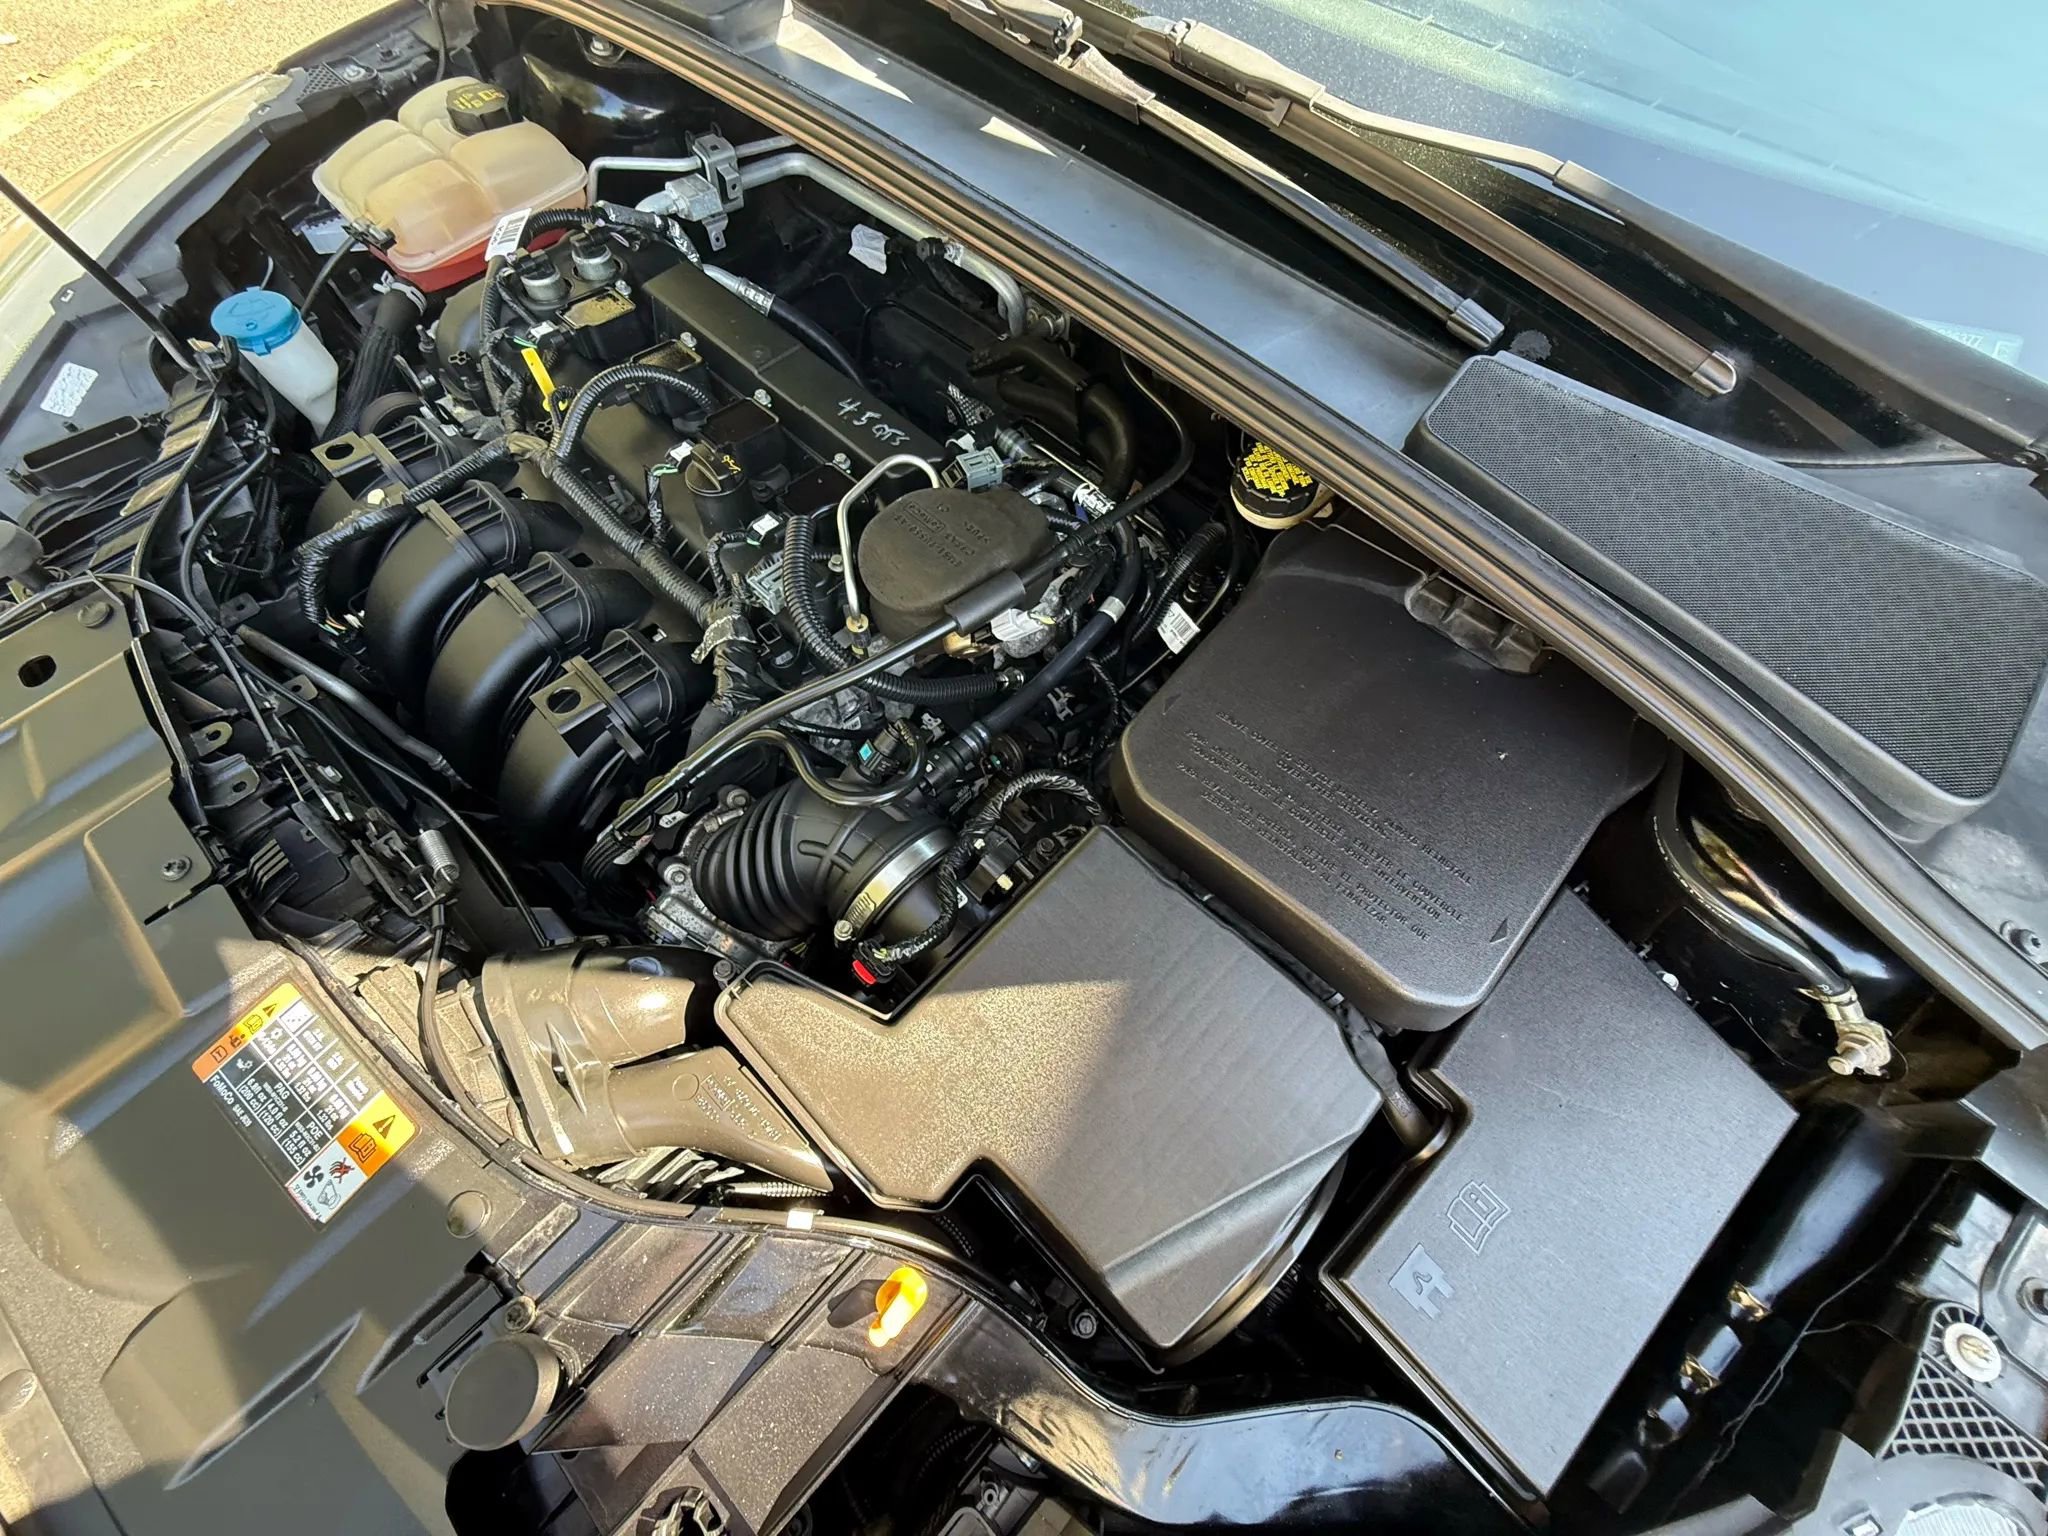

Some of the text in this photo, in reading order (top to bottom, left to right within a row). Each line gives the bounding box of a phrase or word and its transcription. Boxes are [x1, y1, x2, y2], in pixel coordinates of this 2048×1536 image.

[1274, 759, 1305, 781] COVER
[1305, 780, 1335, 802] AFTER
[1250, 731, 1279, 752] COVER
[1295, 759, 1335, 788] SERVICE
[1419, 843, 1476, 886] REINSTALL
[1232, 772, 1270, 799] REPOSER
[1288, 809, 1339, 845] COUVERCLE
[1371, 866, 1447, 924] INTERVENTION.
[1256, 828, 1318, 872] REINSTALADO
[1351, 837, 1394, 871] ENLEVER
[1409, 880, 1465, 923] COUVERCLE
[1301, 844, 1338, 874] RETIRE
[1354, 882, 1409, 925] PROTECTOR
[1409, 924, 1432, 944] QUE
[210, 1075, 233, 1104] FoMoCo
[232, 1104, 243, 1116] SAE
[238, 1085, 261, 1110] (200 cc)
[257, 1092, 266, 1102] oz
[274, 1082, 289, 1099] PAG
[258, 1110, 281, 1136] (120 cc)
[267, 1103, 278, 1114] 4.0
[278, 1118, 288, 1128] oz
[316, 1109, 328, 1122] 1.32
[289, 1130, 301, 1143] 5.2
[302, 1147, 311, 1156] oz
[306, 1121, 322, 1139] POE
[281, 1138, 304, 1165] (155 cc)
